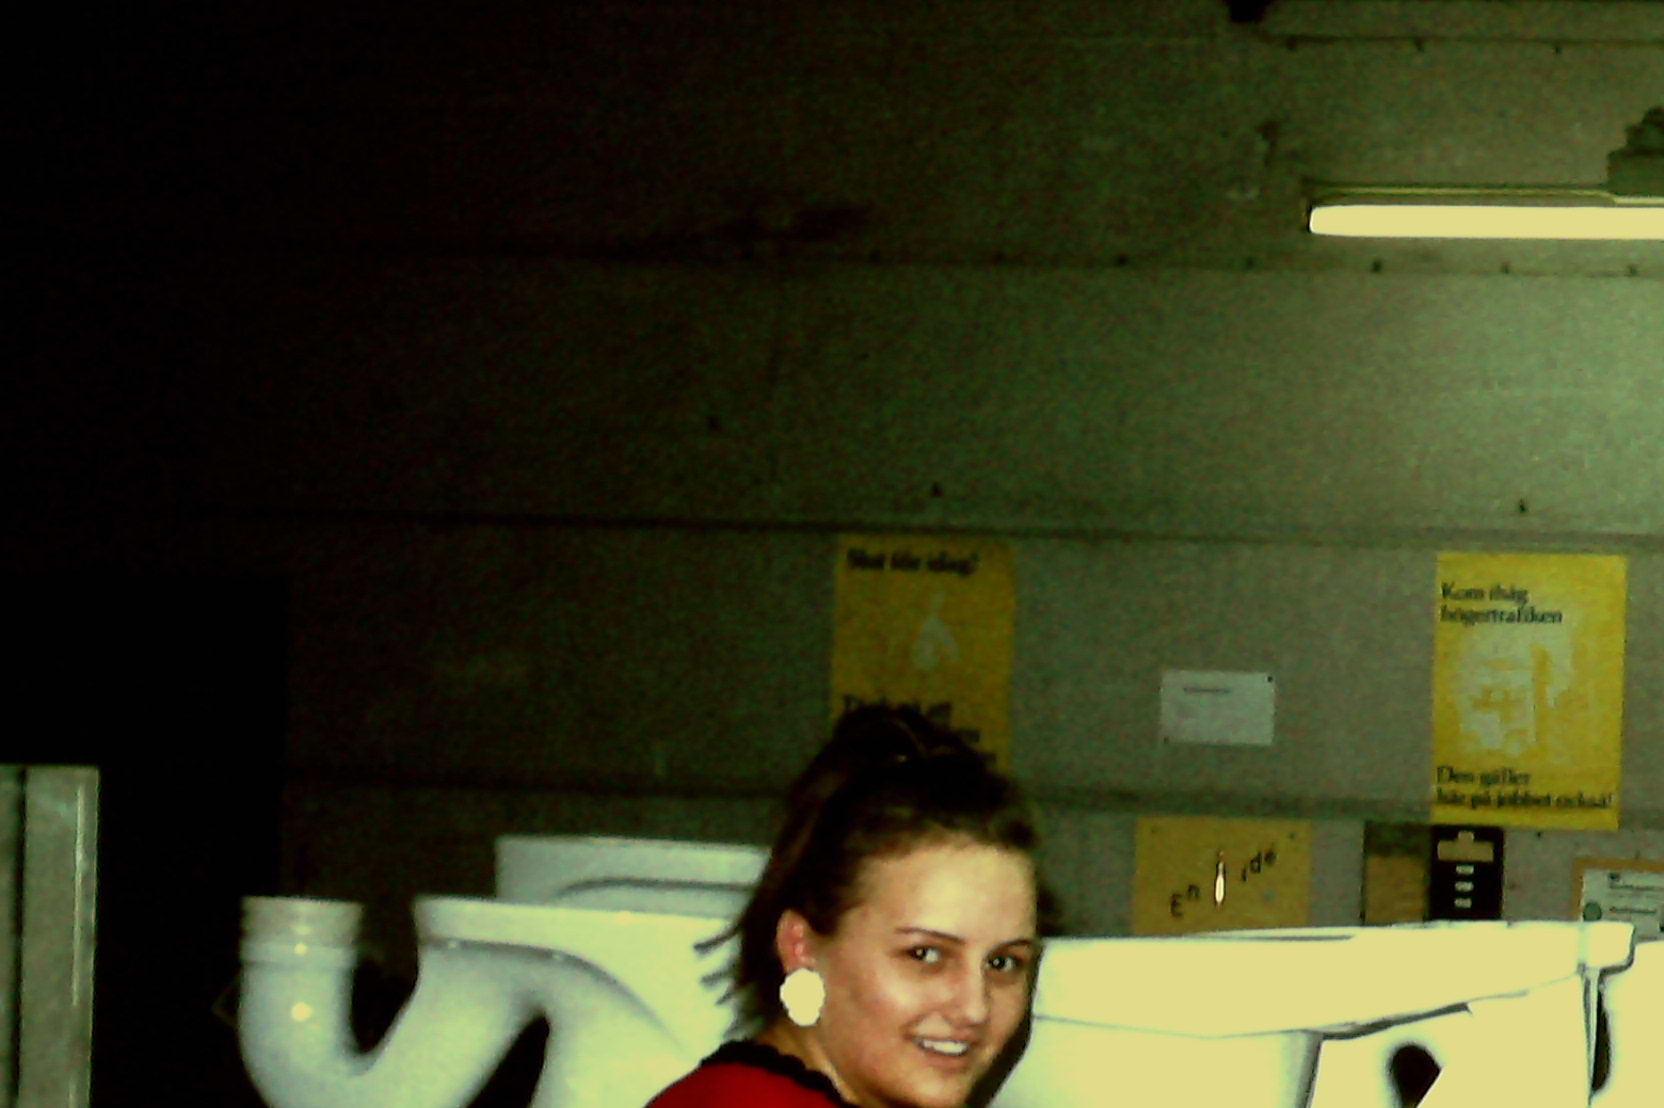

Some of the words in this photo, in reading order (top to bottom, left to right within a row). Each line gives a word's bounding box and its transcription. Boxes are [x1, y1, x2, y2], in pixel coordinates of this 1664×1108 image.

[1440, 581, 1485, 600] Kom
[1489, 583, 1529, 605] ihåg
[1440, 604, 1564, 626] högertrafiken
[1437, 766, 1474, 784] Den
